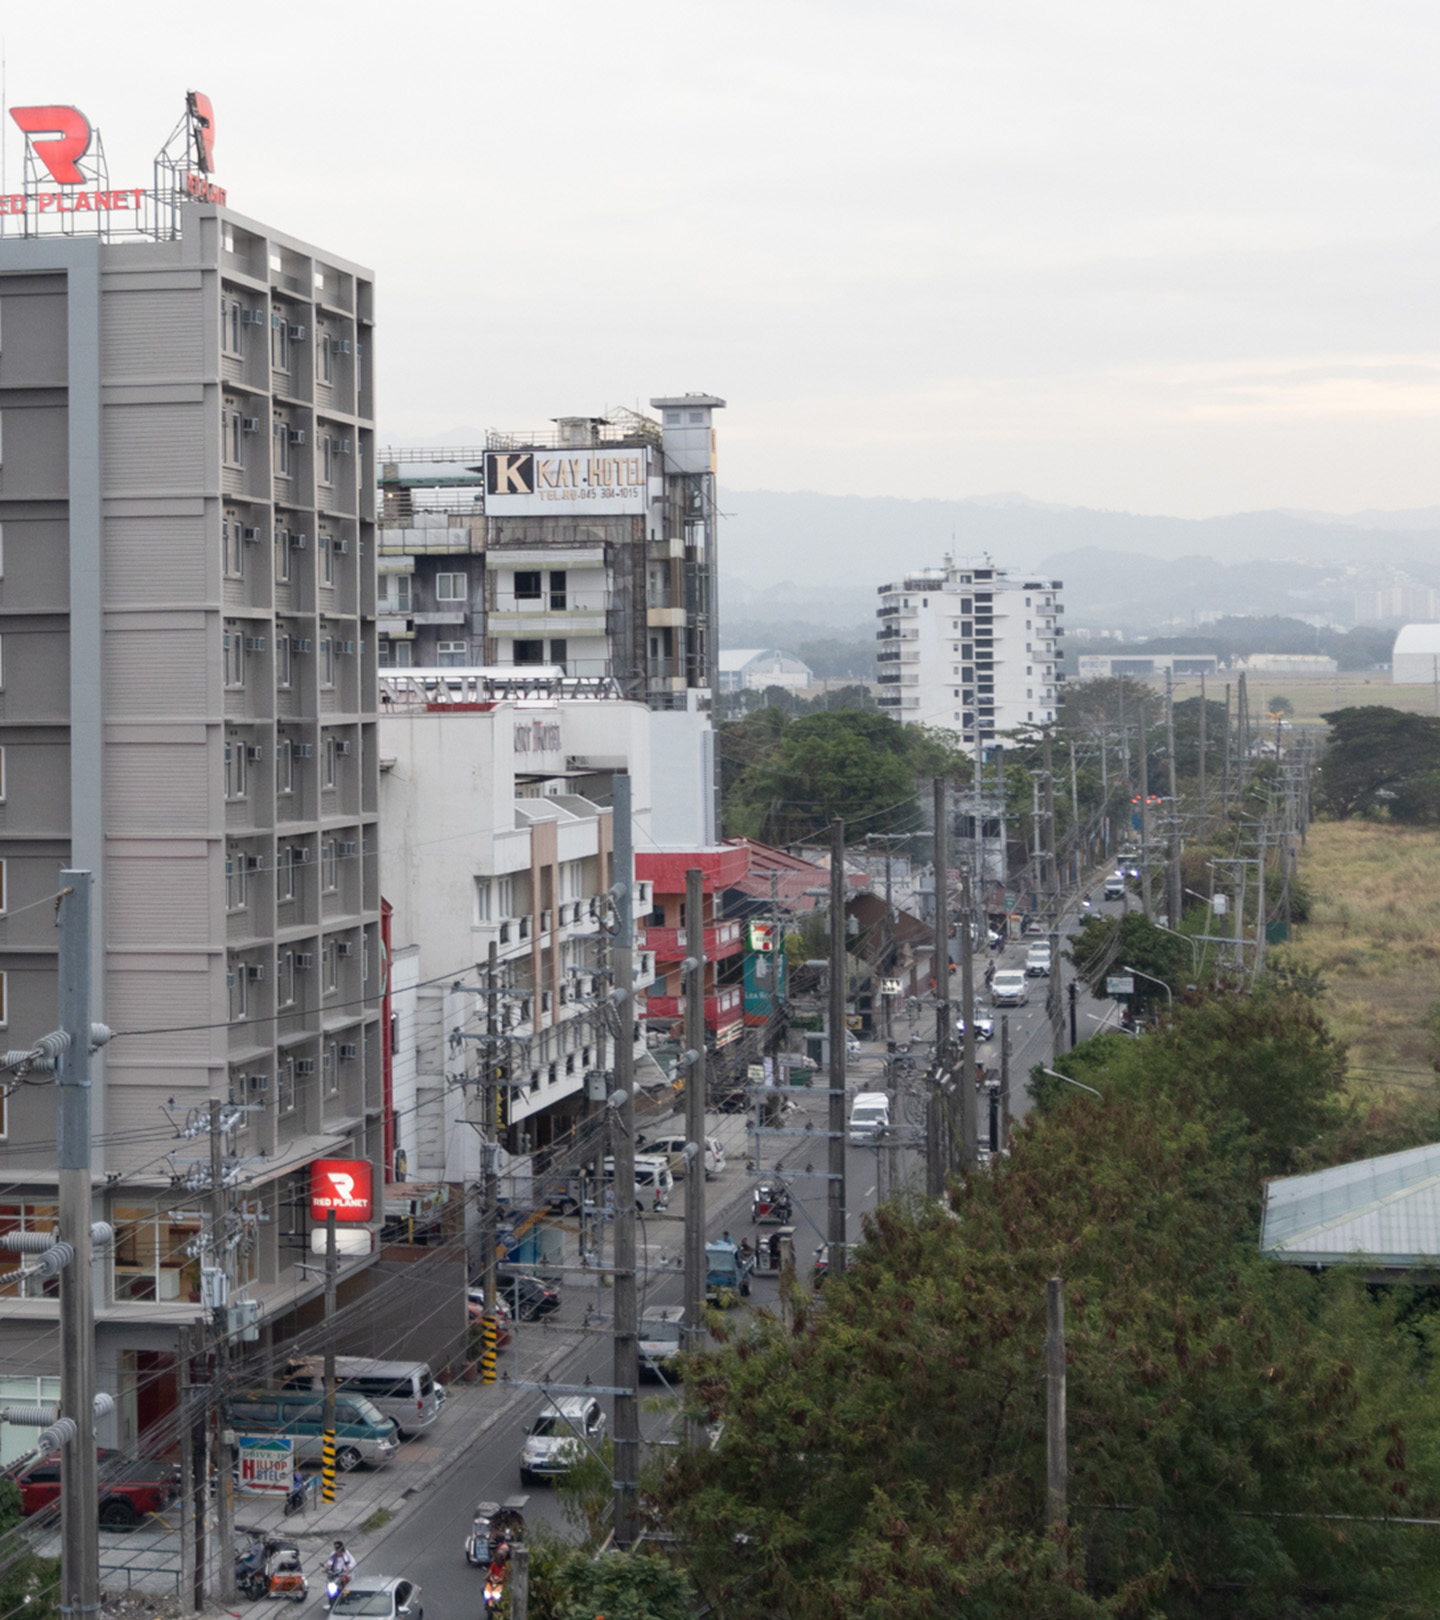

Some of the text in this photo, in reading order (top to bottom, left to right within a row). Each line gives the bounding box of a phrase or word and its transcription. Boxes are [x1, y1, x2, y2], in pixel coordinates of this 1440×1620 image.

[38, 188, 145, 213] PLANET
[494, 454, 532, 494] K
[313, 1197, 368, 1207] RED PLANET
